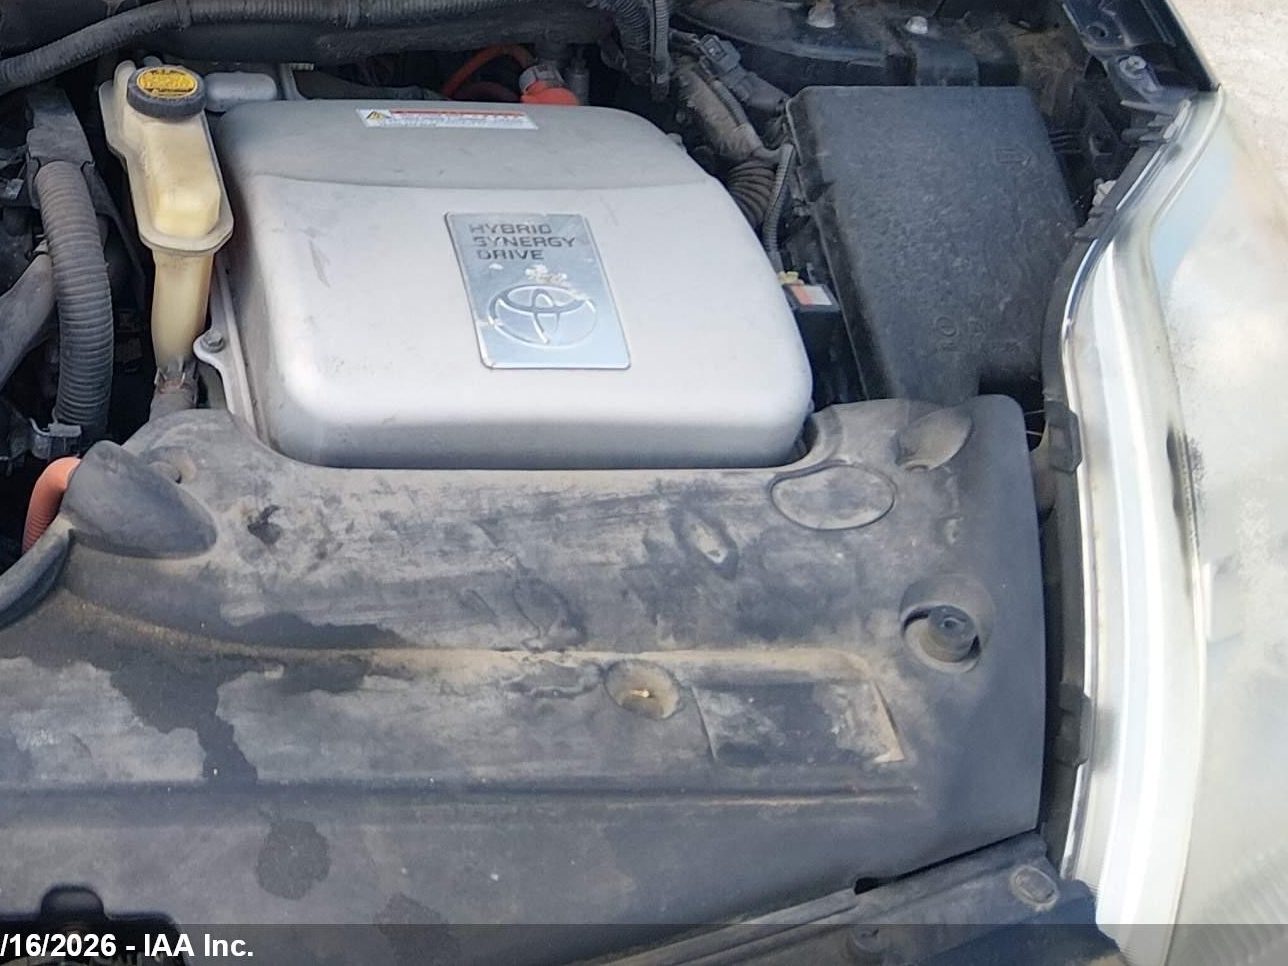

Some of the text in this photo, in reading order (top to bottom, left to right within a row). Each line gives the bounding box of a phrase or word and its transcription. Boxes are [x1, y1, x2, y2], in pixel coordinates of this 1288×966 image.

[469, 224, 552, 235] HYBRID
[473, 236, 576, 247] SYNERGY
[477, 249, 544, 260] DRIVE
